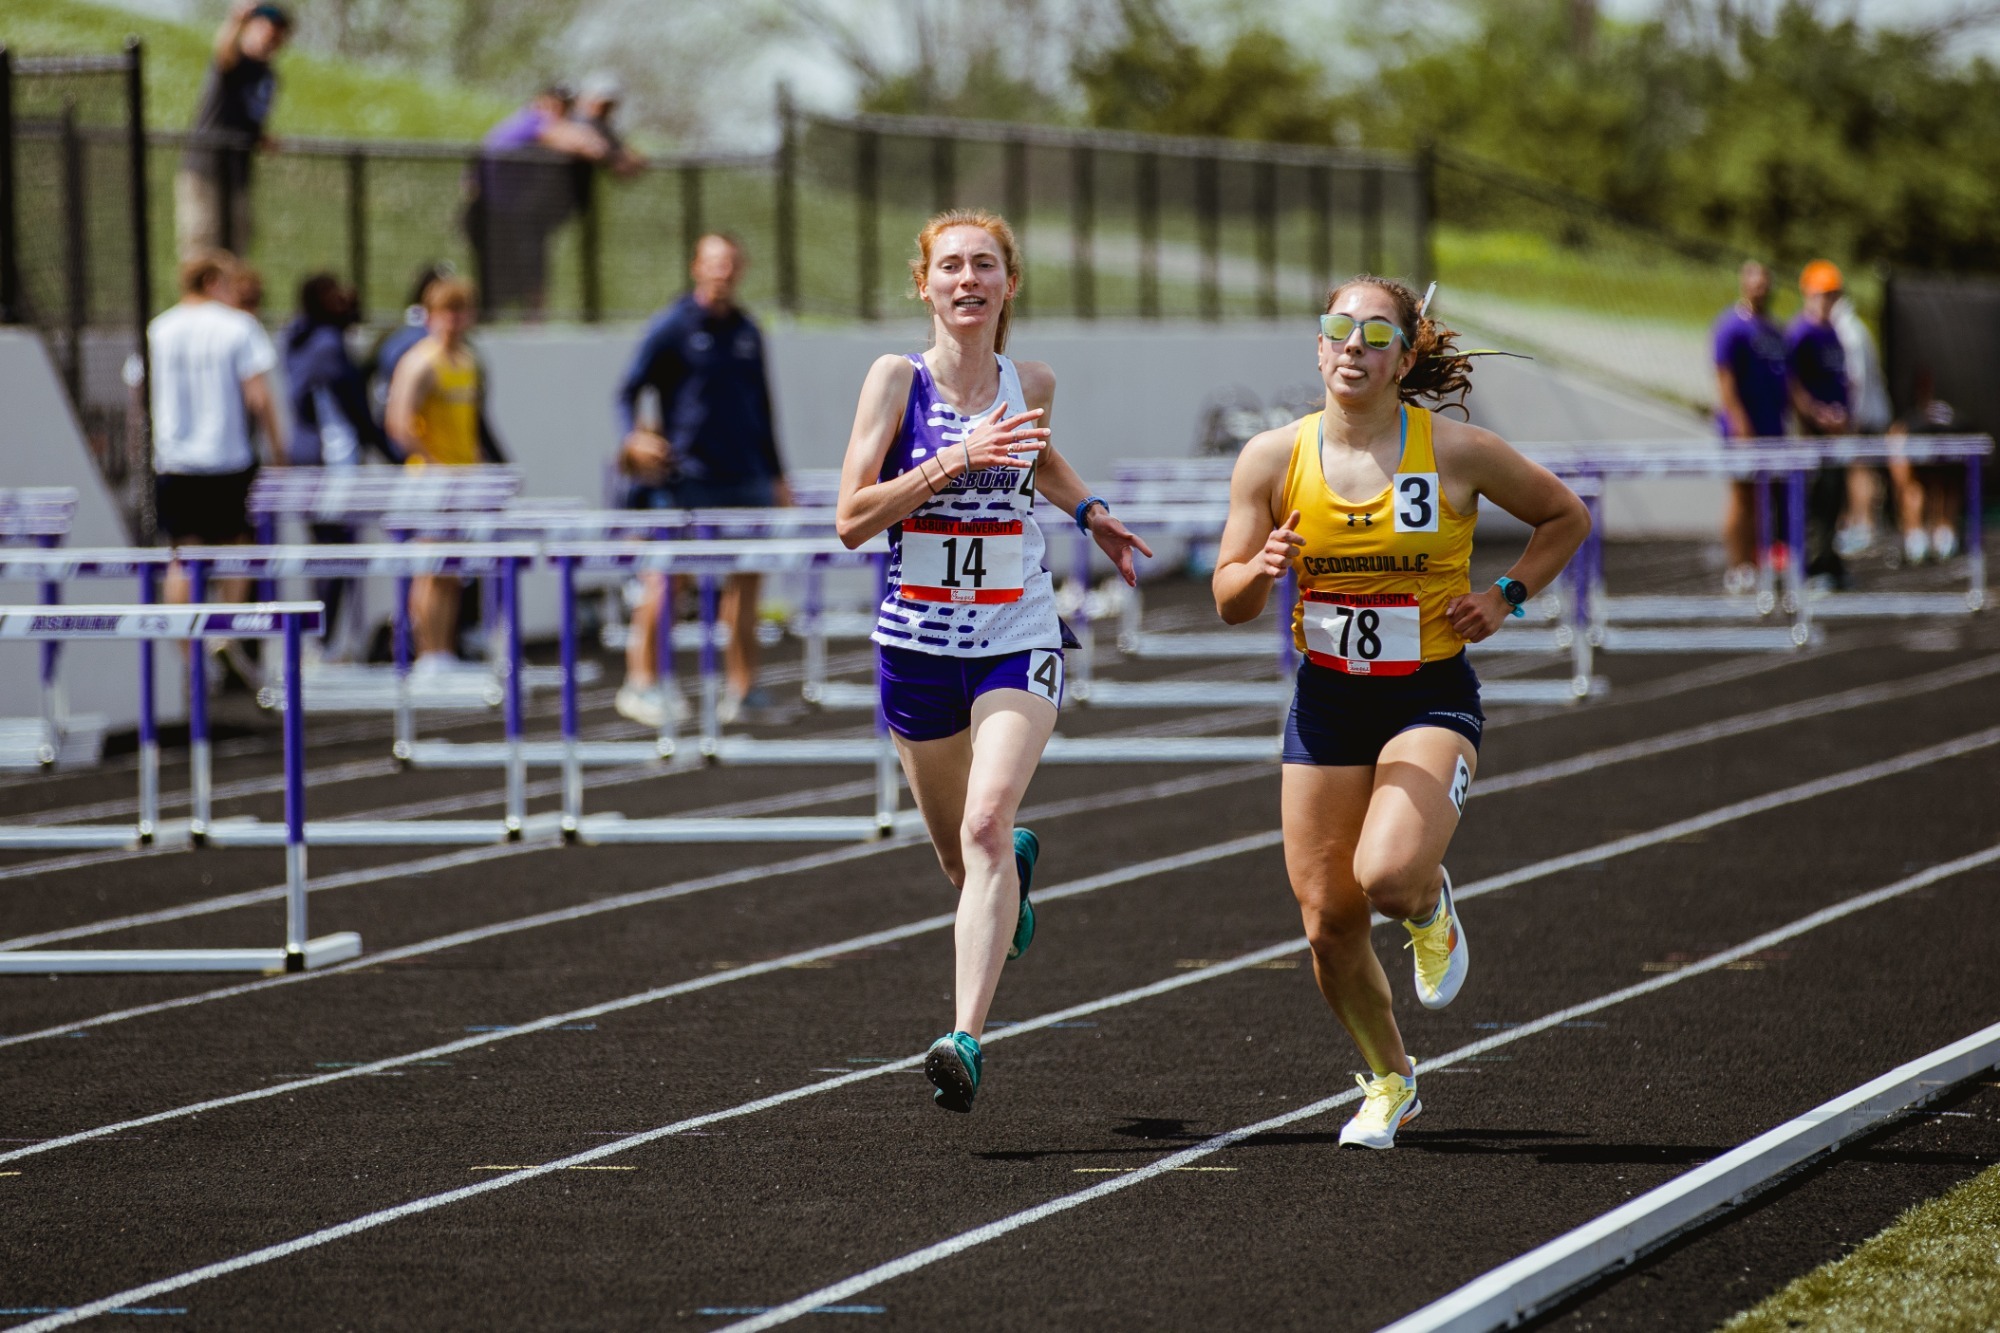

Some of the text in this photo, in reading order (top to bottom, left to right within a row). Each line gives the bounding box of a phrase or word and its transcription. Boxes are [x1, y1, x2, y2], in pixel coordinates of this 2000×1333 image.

[946, 471, 1020, 489] SBURY
[1018, 458, 1036, 508] 4
[1400, 476, 1432, 528] 3
[914, 519, 1015, 534] ASBURY UNIVERSITY
[941, 537, 987, 588] 14
[1302, 553, 1430, 576] CEDARVILLE
[1348, 593, 1410, 605] UNIVERSITY
[1336, 606, 1382, 660] 78
[1033, 654, 1057, 700] 4
[1455, 765, 1469, 813] 3
